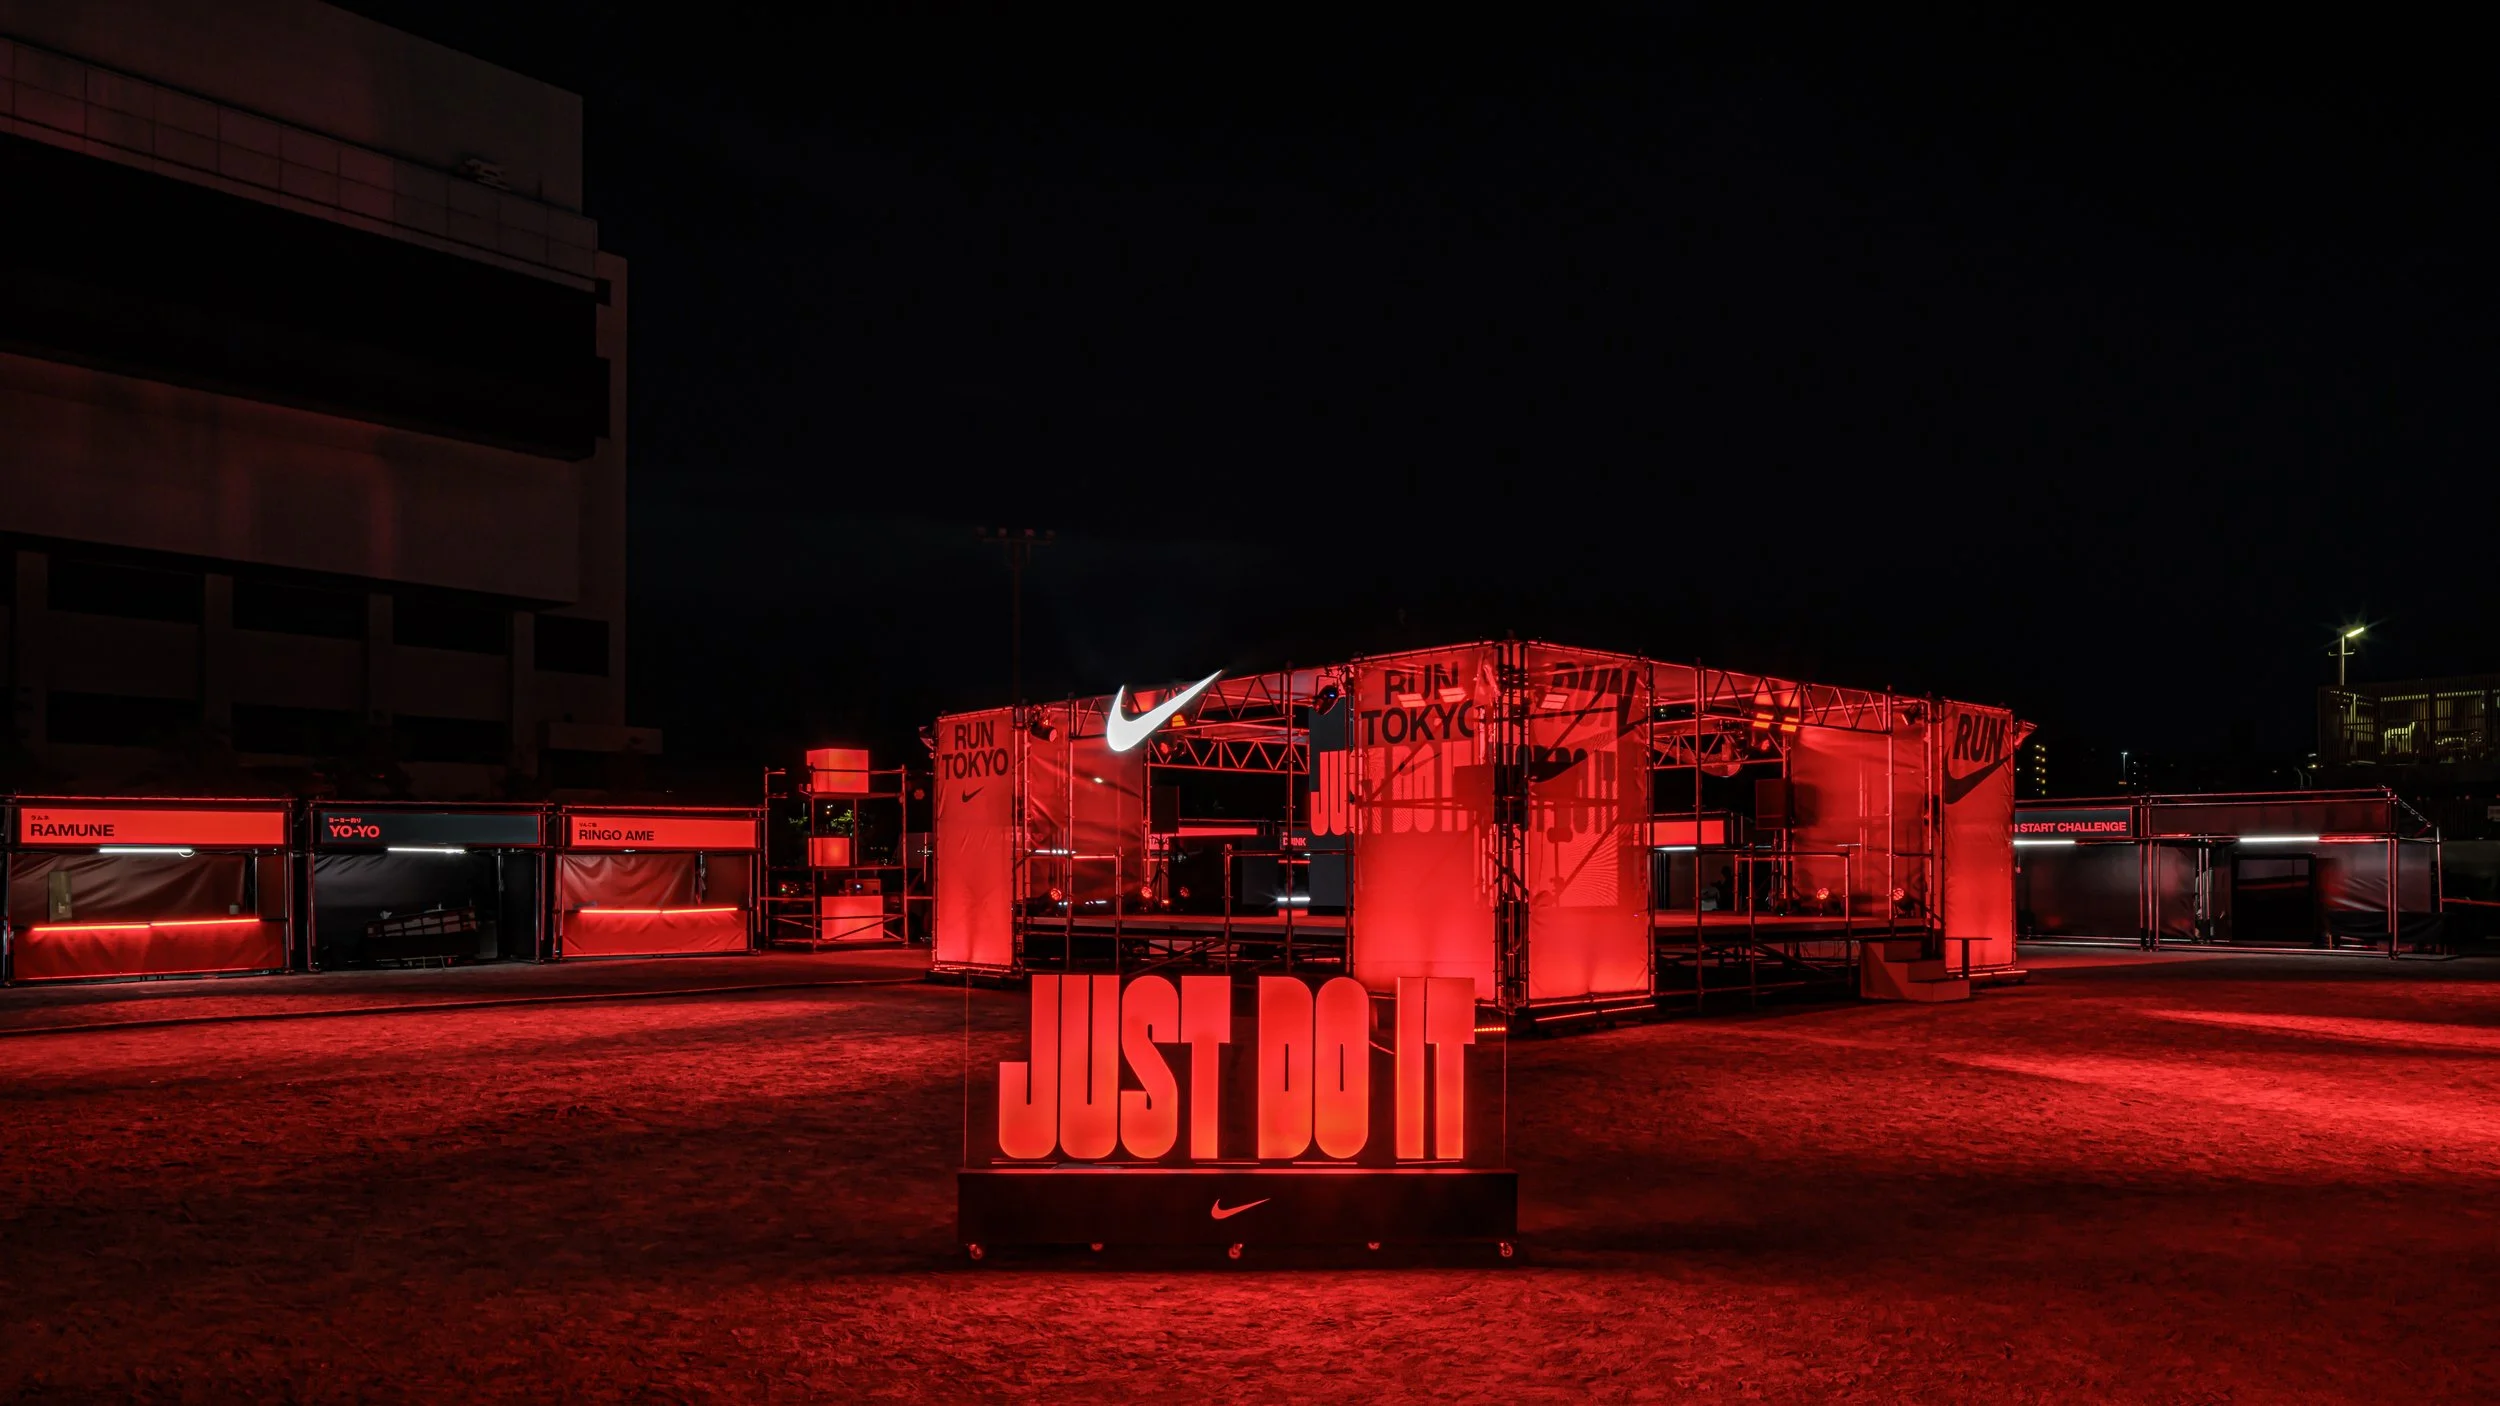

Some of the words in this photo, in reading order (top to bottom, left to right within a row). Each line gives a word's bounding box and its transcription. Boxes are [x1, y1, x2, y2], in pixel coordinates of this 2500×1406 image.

[1384, 662, 1459, 706] RUN
[954, 720, 994, 750] RUN
[1952, 713, 2006, 763] RUN
[942, 748, 1009, 780] TOKYO
[30, 823, 115, 837] RAMUNE
[329, 825, 380, 838] YO-YO
[579, 829, 622, 841] RINGO
[625, 830, 655, 841] AME
[2020, 822, 2056, 833] START
[2057, 821, 2127, 832] CHALLENGE
[998, 974, 1231, 1160] JUST
[1258, 976, 1370, 1160] DO
[1396, 976, 1476, 1160] IT
